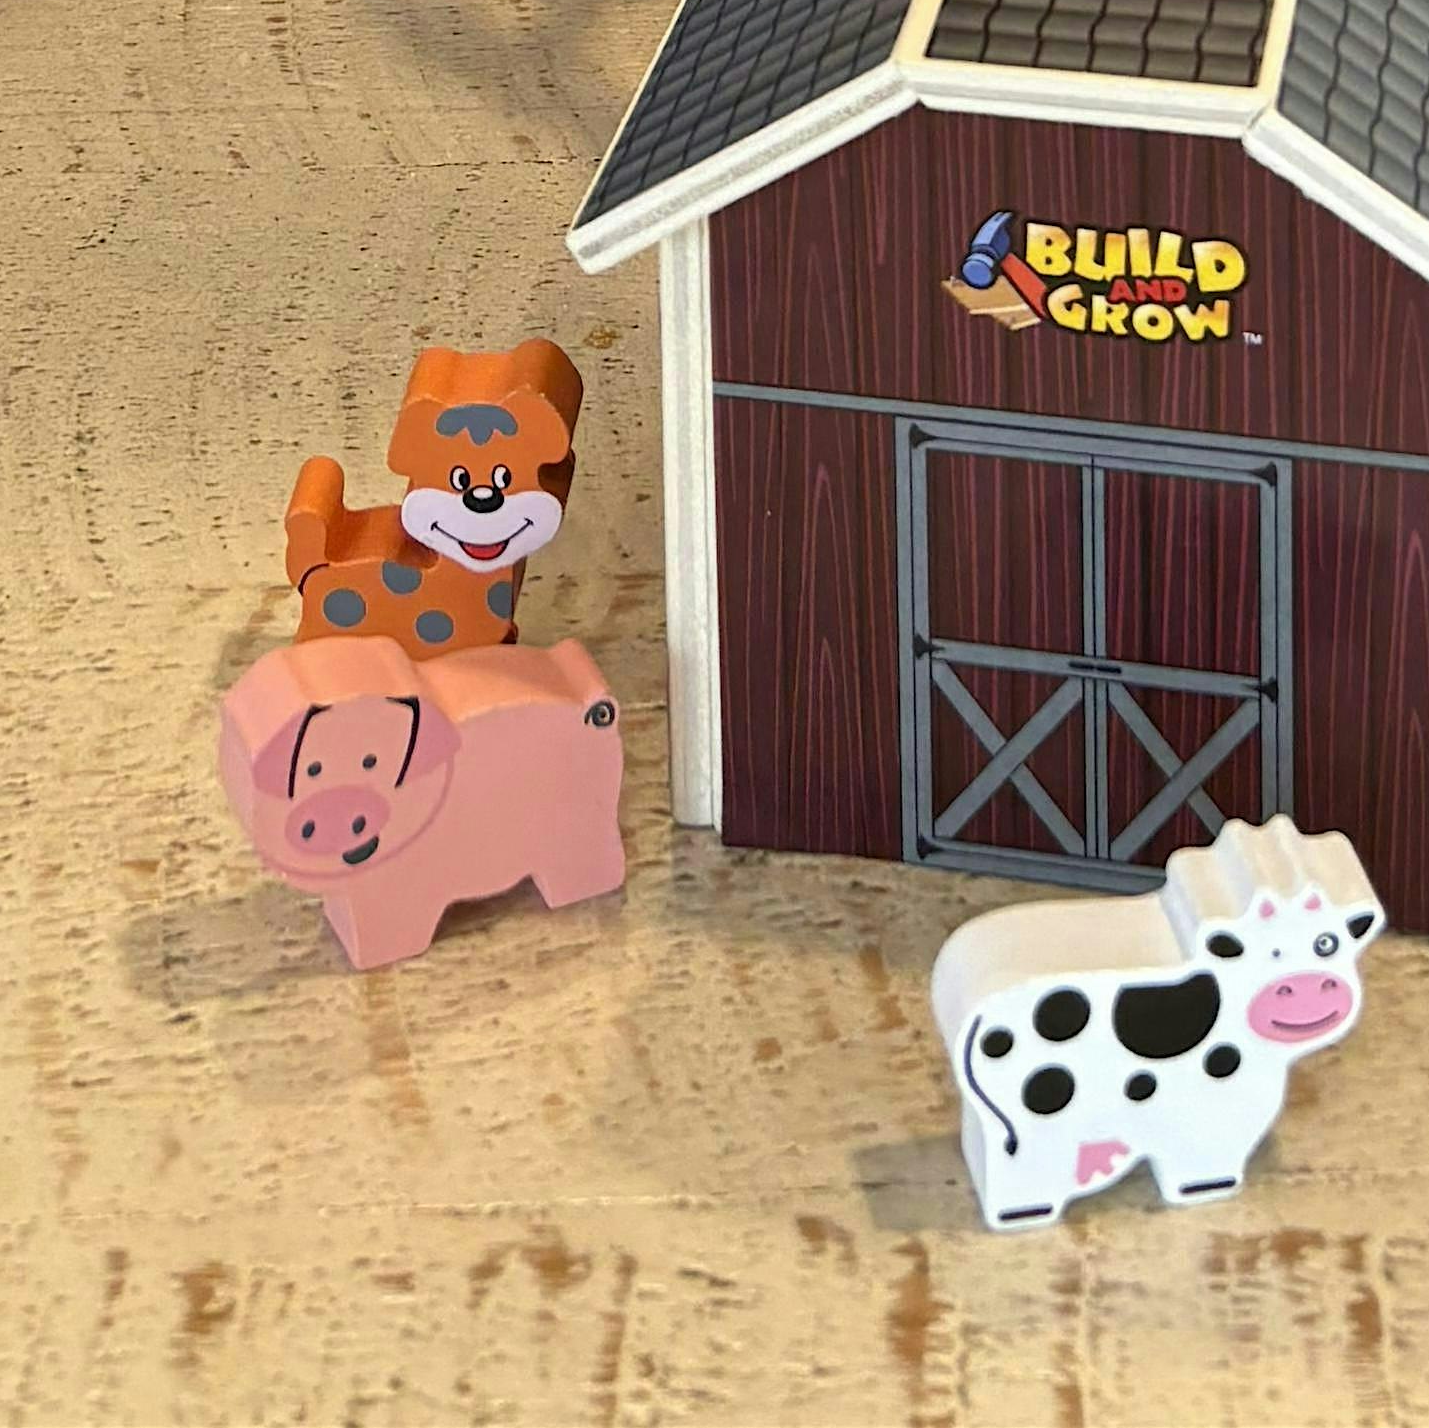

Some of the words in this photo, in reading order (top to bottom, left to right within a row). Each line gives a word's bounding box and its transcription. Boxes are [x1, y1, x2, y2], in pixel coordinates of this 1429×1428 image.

[1026, 222, 1246, 293] BUILD
[1047, 283, 1230, 342] GROW
[1107, 277, 1188, 304] AND
